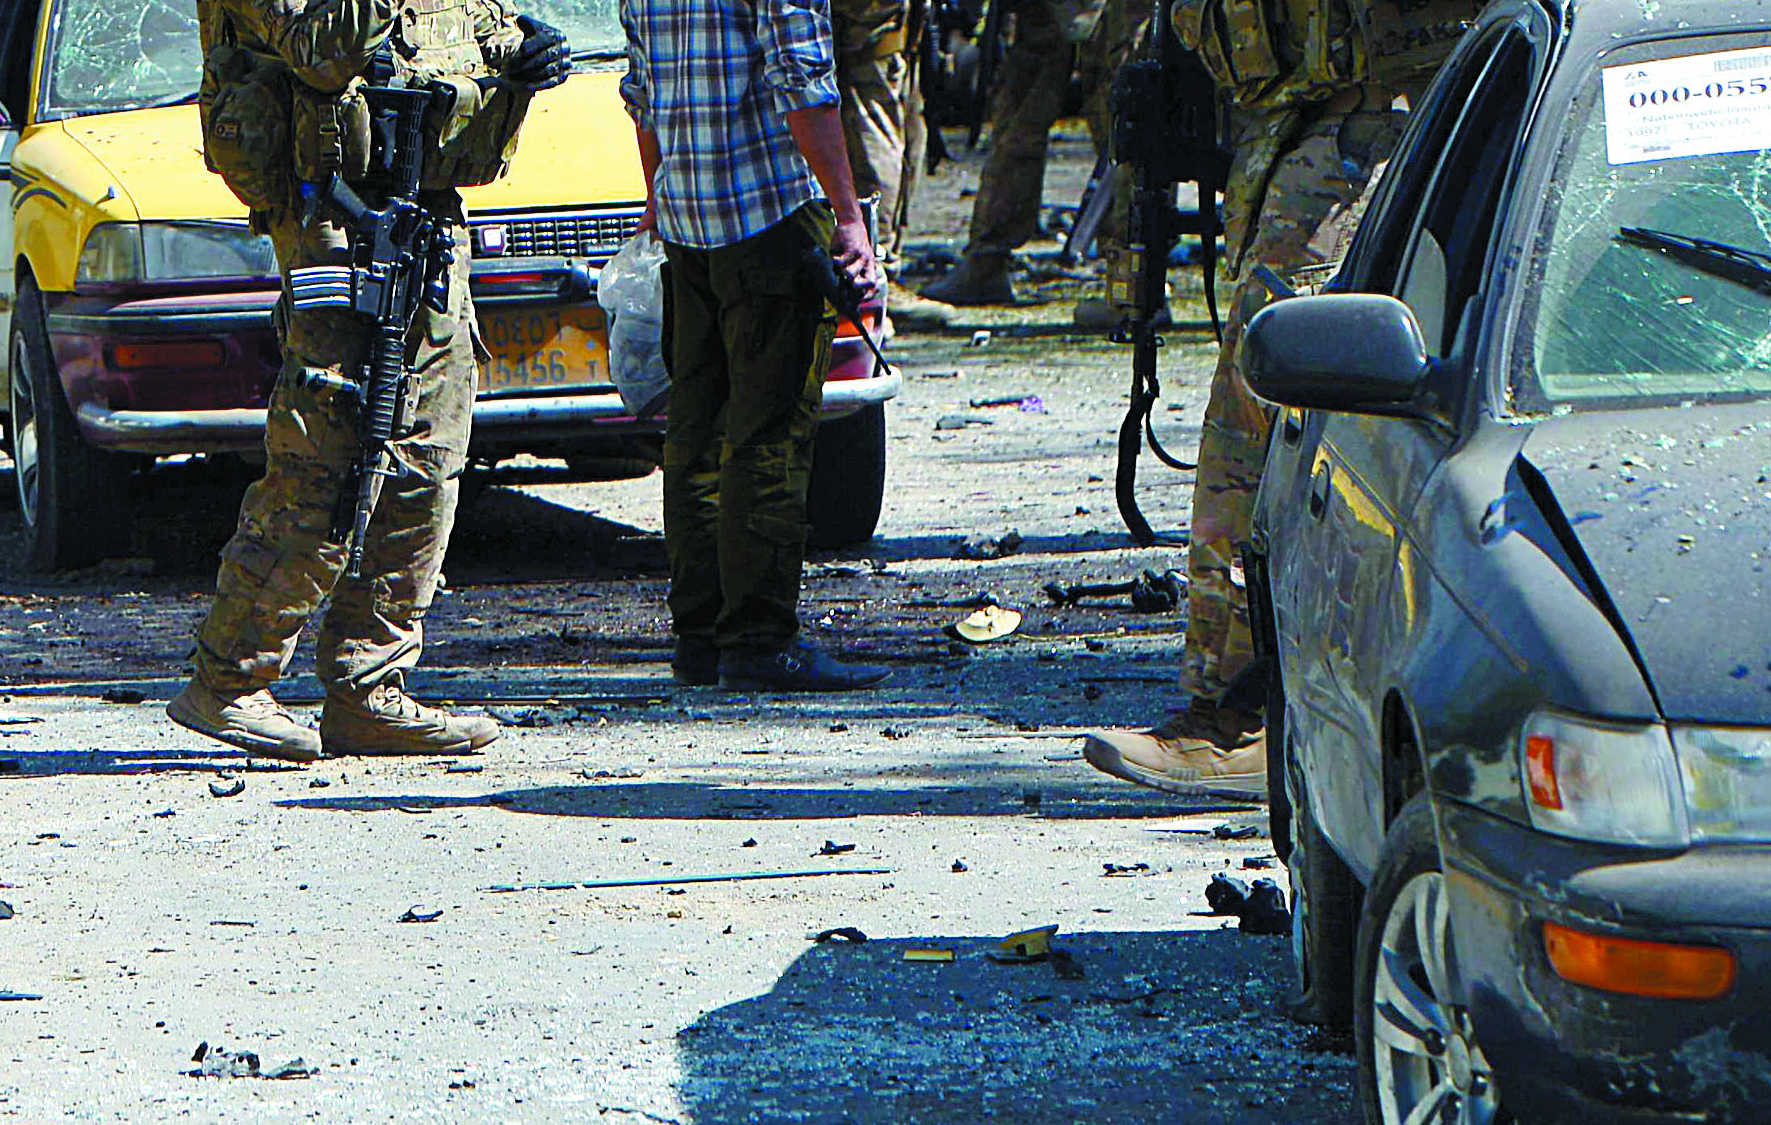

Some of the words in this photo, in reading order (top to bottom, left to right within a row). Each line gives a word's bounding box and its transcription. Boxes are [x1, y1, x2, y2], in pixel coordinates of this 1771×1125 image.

[1629, 77, 1771, 108] 000-055
[1687, 117, 1752, 131] TOYOTA
[484, 348, 567, 386] 15456
